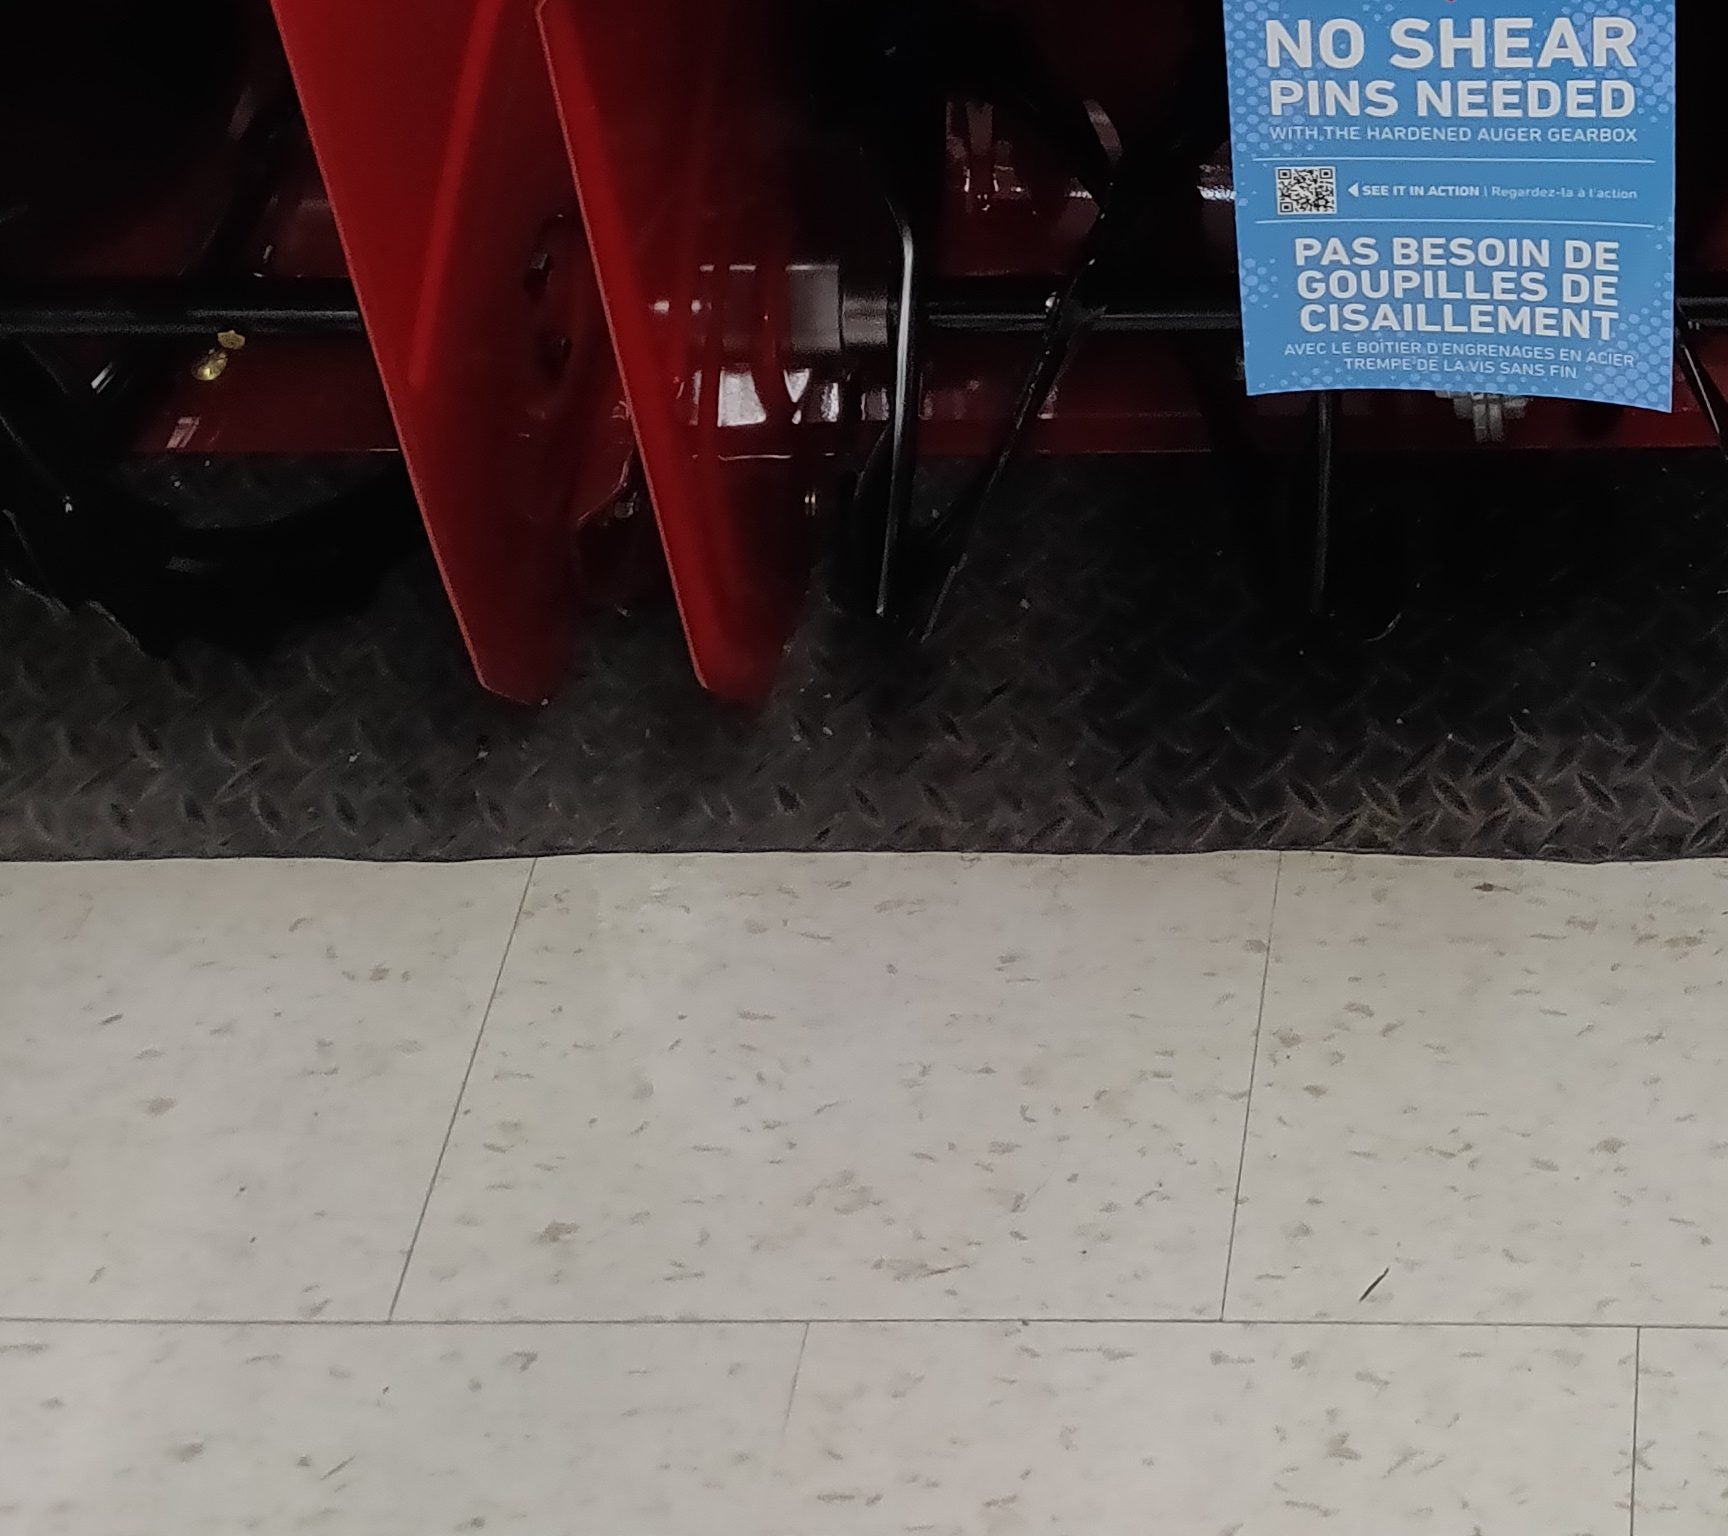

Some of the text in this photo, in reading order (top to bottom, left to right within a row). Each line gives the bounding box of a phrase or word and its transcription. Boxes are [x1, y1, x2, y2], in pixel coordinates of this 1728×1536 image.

[1265, 17, 1638, 69] NO SHEAR
[1269, 79, 1636, 118] PINS NEEDED
[1270, 126, 1638, 143] WITH THE HARDENED AUGER GEARBOX
[1362, 185, 1638, 200] SEE IT IN ACTION Regardez-la à l'action
[1295, 237, 1620, 271] PAS BESOIN DE
[1297, 269, 1619, 307] GOUPILLES DE
[1300, 303, 1620, 341] CISAILLEMENT
[1284, 342, 1327, 356] AVEC
[1331, 341, 1351, 355] LE
[1427, 342, 1555, 361] D'ENGRENAGES
[1560, 348, 1582, 362] EN
[1586, 351, 1635, 367] ACIER
[1416, 358, 1438, 371] DE
[1443, 359, 1465, 373] LA
[1467, 359, 1495, 374] VIS
[1499, 362, 1546, 376] SANS
[1550, 364, 1578, 378] FIN
